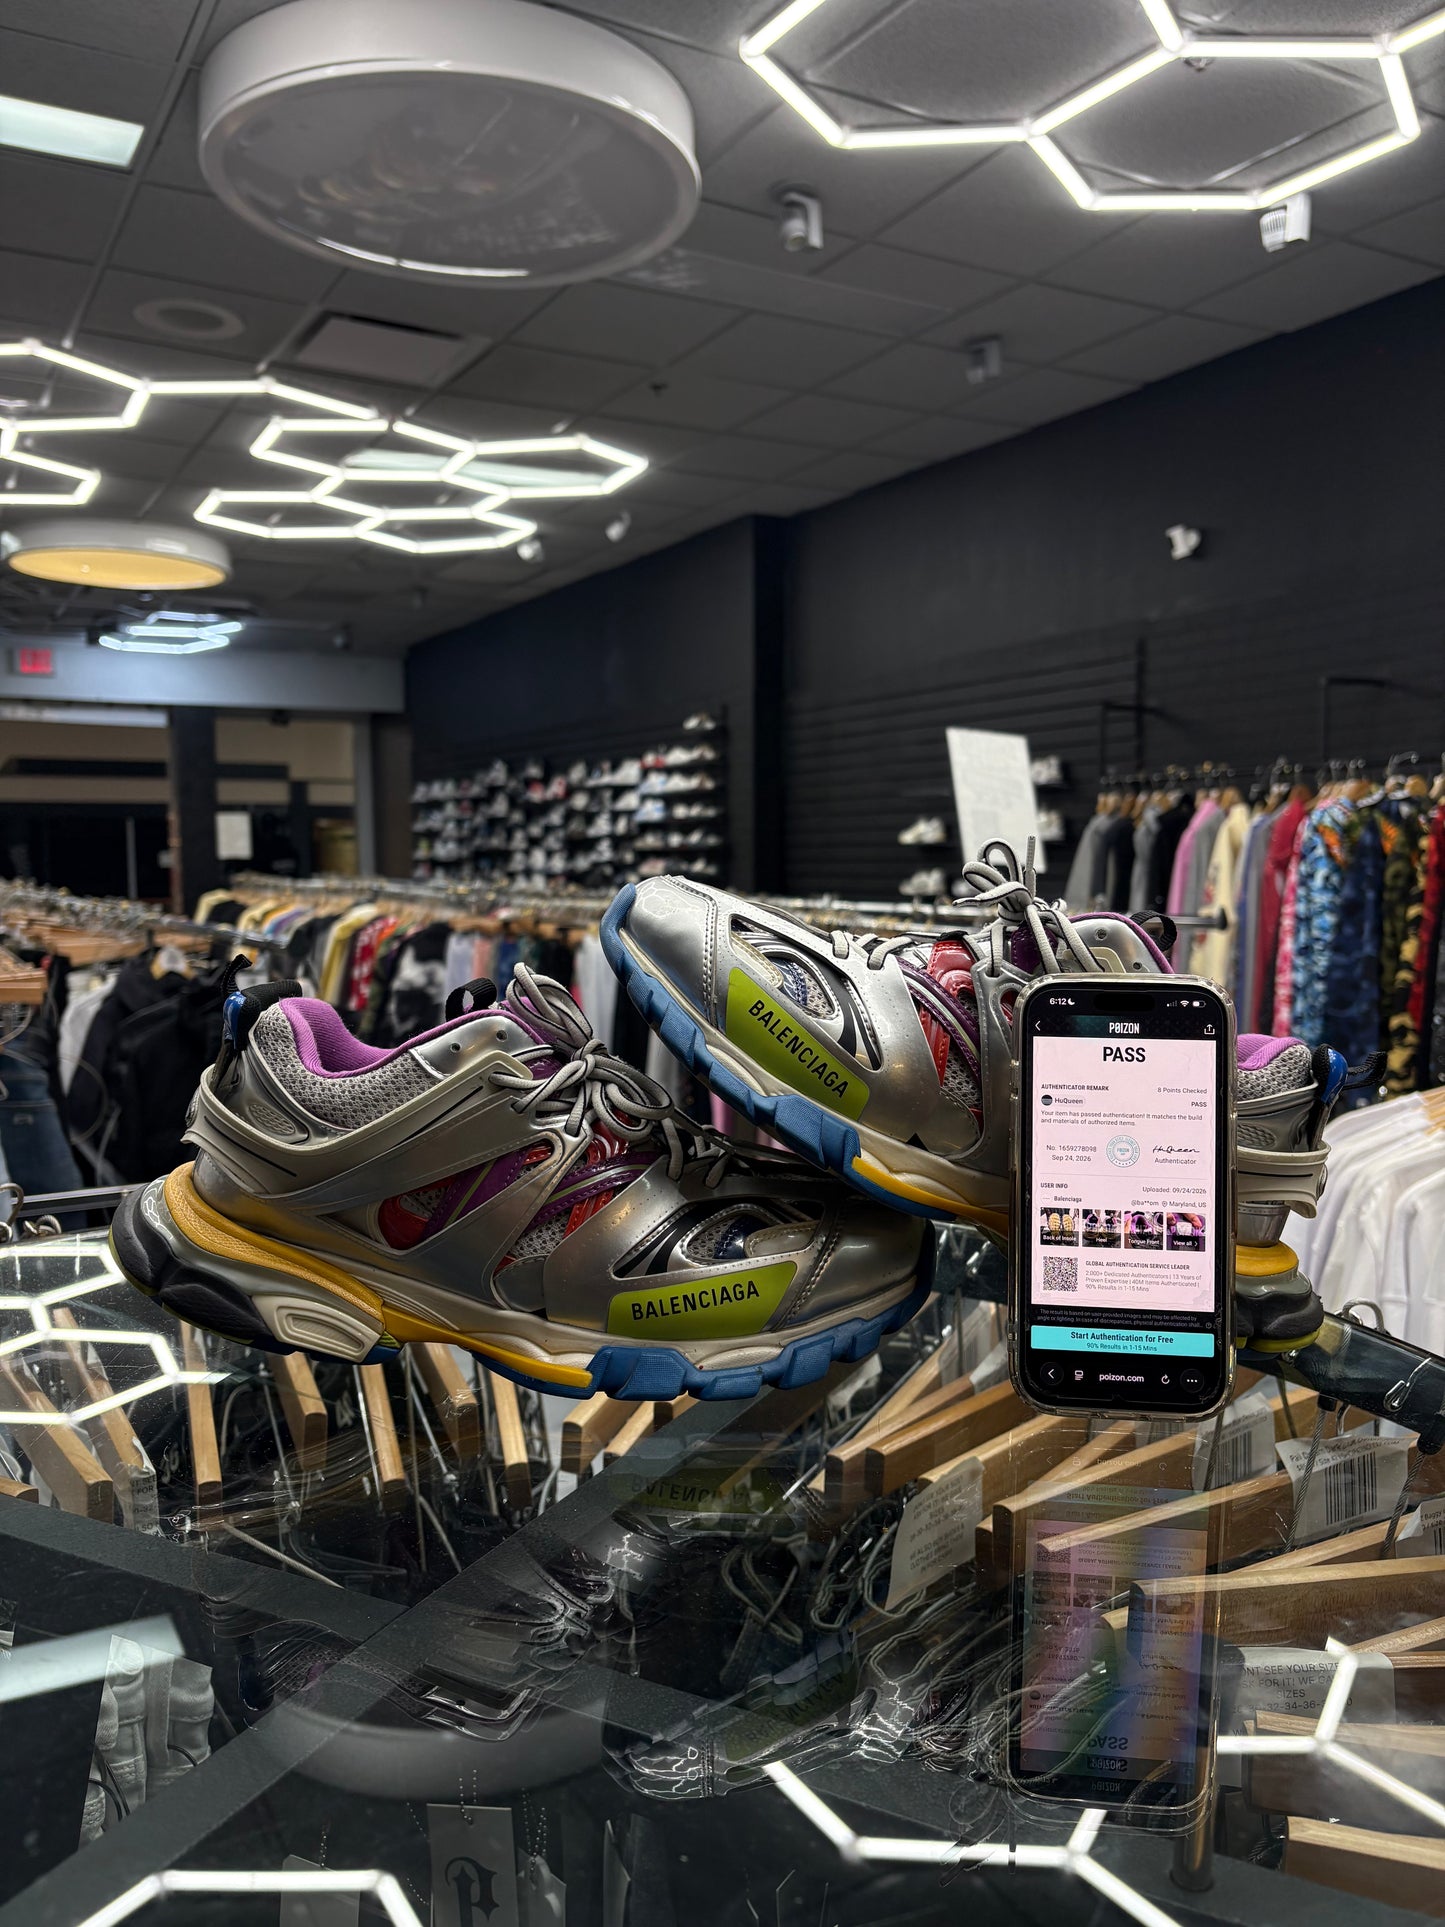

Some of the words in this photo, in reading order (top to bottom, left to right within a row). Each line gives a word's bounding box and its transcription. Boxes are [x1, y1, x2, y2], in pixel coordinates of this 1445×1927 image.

[748, 999, 849, 1099] BALENCIAGA
[1103, 1047, 1146, 1062] PASS
[631, 1280, 760, 1321] BALENCIAGA
[1070, 1331, 1089, 1340] Start
[1090, 1332, 1143, 1342] Authentication
[1145, 1334, 1156, 1342] for
[1157, 1335, 1174, 1343] Free
[1099, 1372, 1145, 1384] poizon.com
[1264, 1664, 1283, 1675] SEE
[1286, 1664, 1316, 1674] YOUR
[1259, 1679, 1280, 1688] FOR
[1283, 1677, 1295, 1687] IT!
[1298, 1676, 1315, 1685] WE
[1277, 1689, 1306, 1699] SIZES
